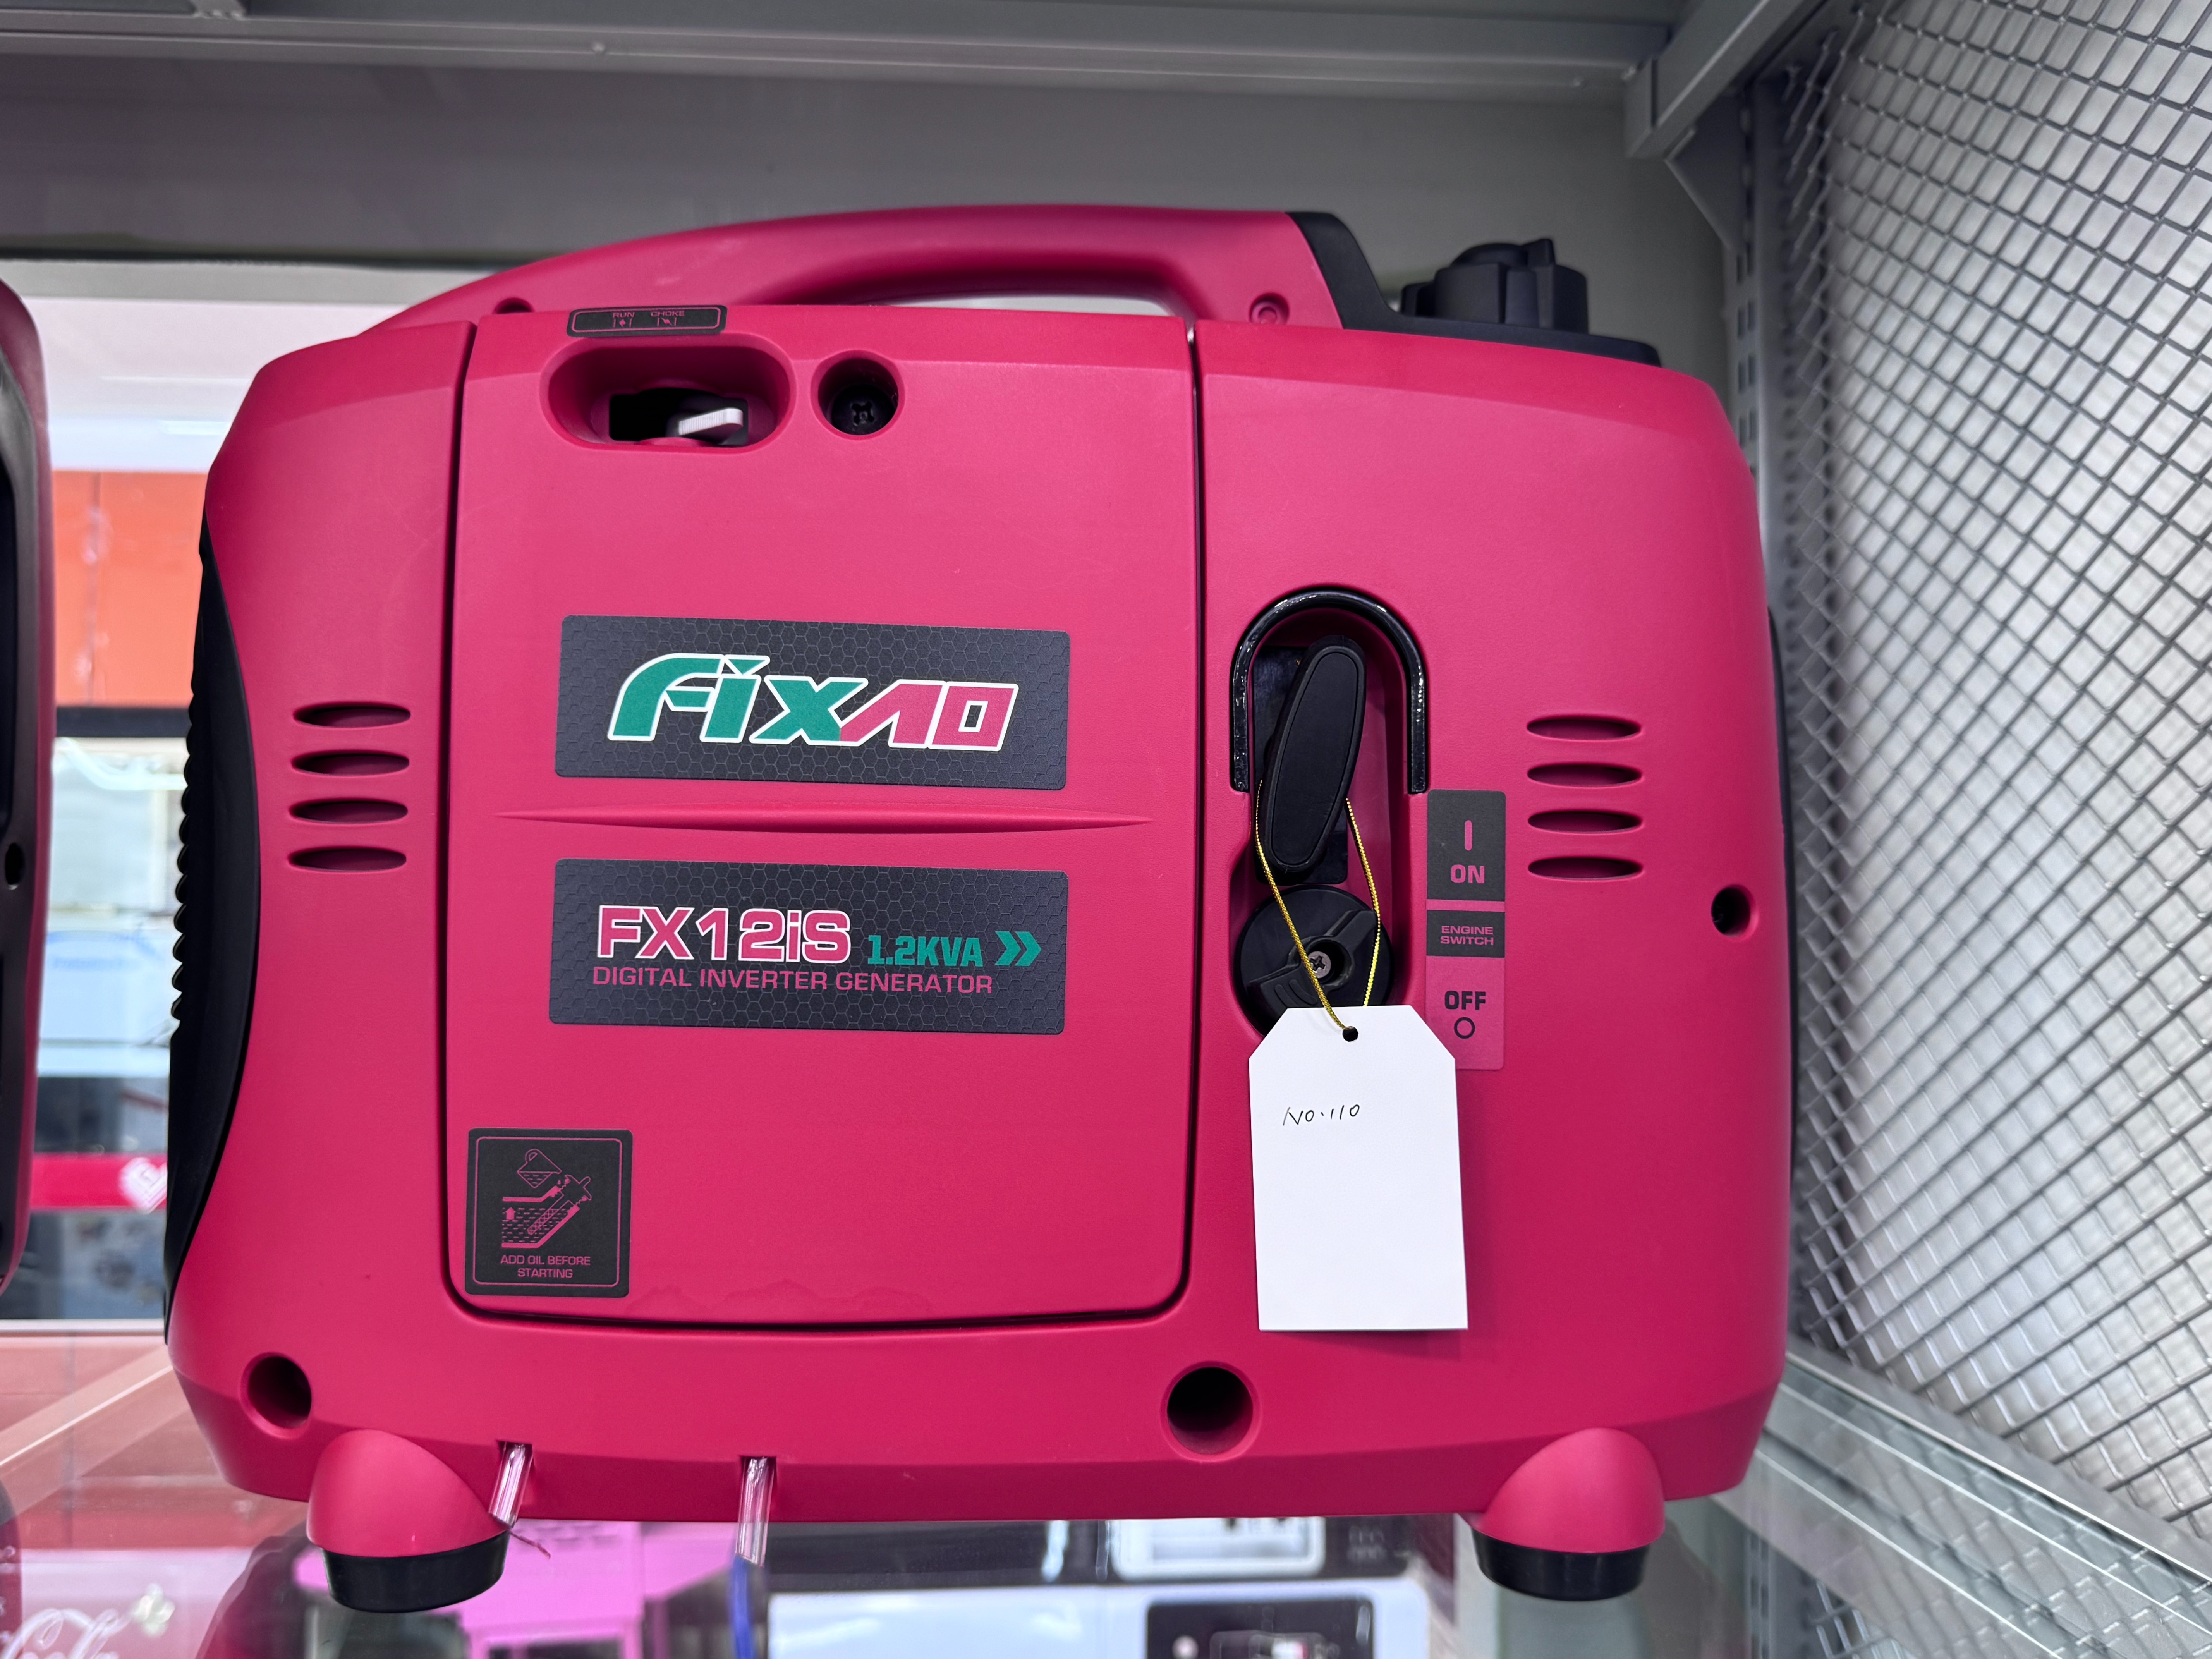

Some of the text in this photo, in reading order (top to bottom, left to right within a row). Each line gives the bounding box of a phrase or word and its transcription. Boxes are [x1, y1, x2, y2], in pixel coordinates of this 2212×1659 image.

[1450, 864, 1485, 884] ON
[1441, 926, 1493, 935] ENGINE
[1440, 936, 1494, 946] SWITCH
[867, 934, 984, 967] 1.2KVA
[592, 966, 993, 994] DIGITAL INVERTER GENERATOR
[1444, 990, 1486, 1010] OFF
[501, 1255, 591, 1266] ADD OIL BEFORE
[518, 1268, 573, 1278] STARTING
